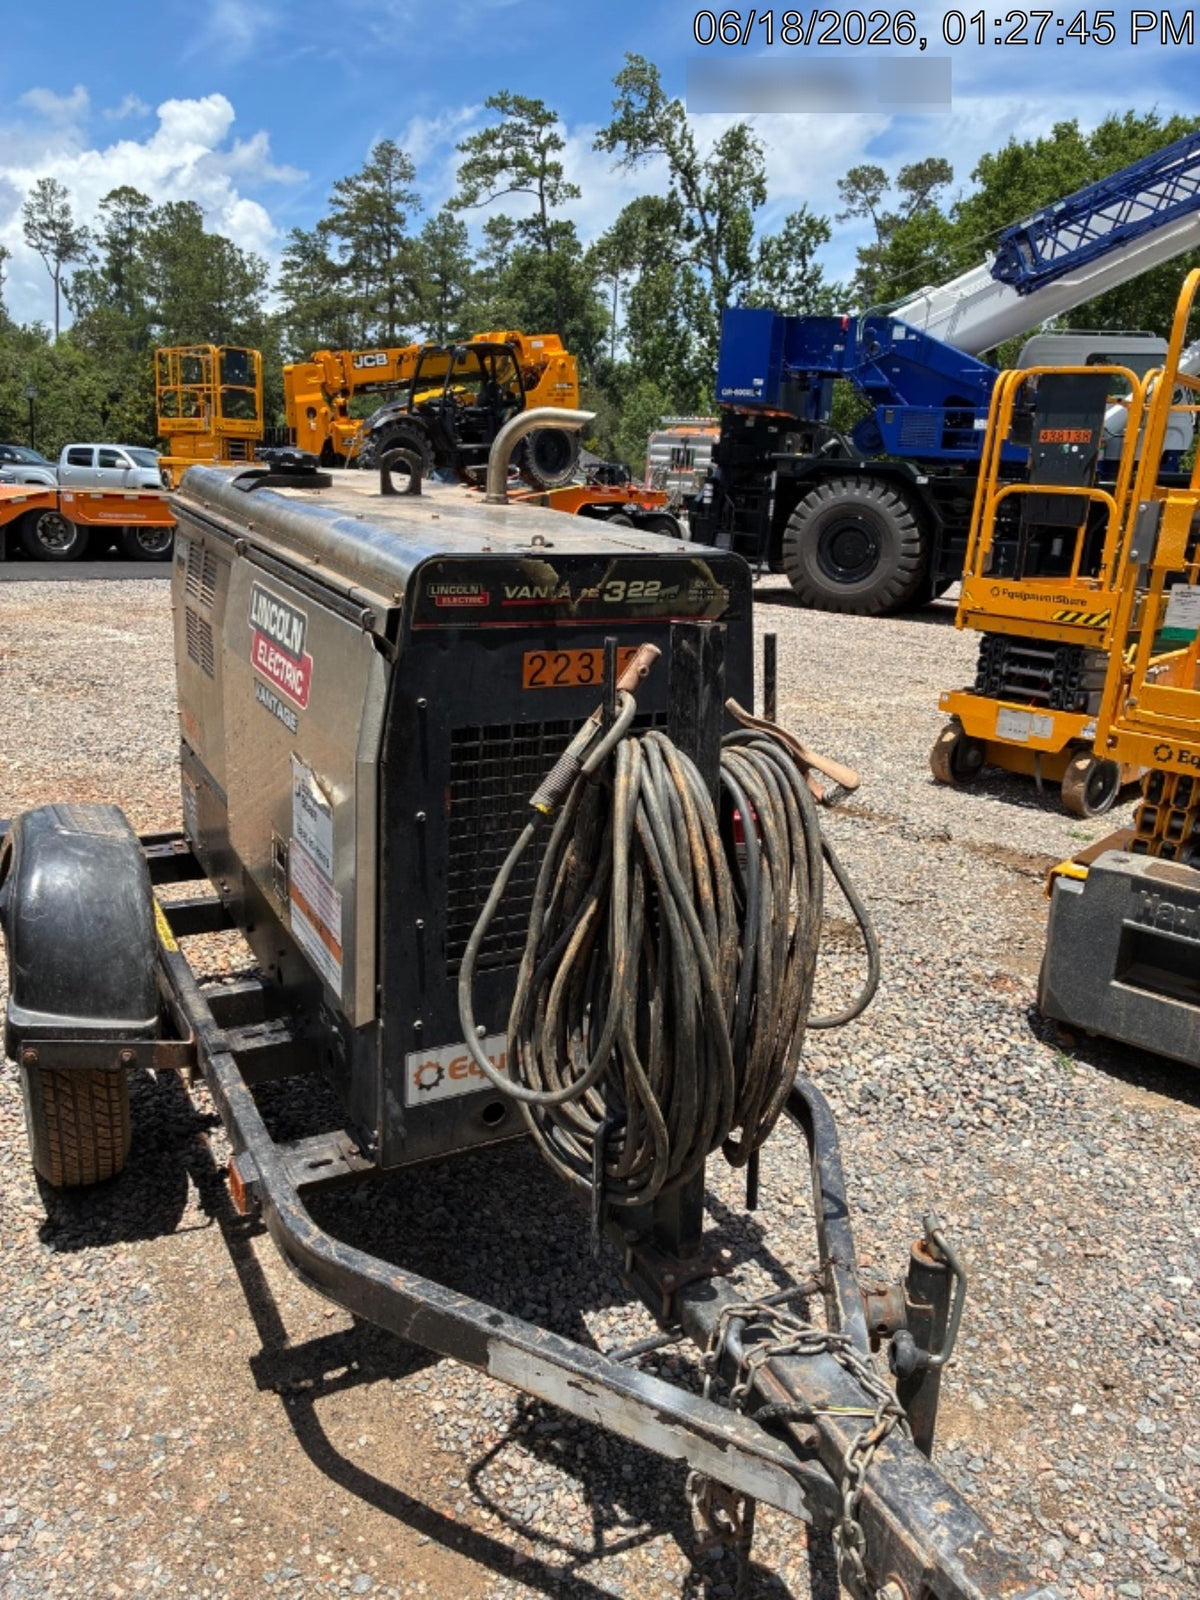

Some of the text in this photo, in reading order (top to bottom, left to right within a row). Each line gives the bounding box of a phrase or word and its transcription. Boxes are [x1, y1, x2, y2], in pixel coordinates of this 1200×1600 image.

[354, 353, 388, 368] JCB
[431, 585, 479, 595] LINCOLN
[442, 596, 485, 604] ELECTRIC
[603, 580, 662, 602] 322
[1002, 587, 1088, 607] EquipmentShare
[251, 590, 304, 655] LINCOLN
[257, 638, 304, 697] ELECTRIC
